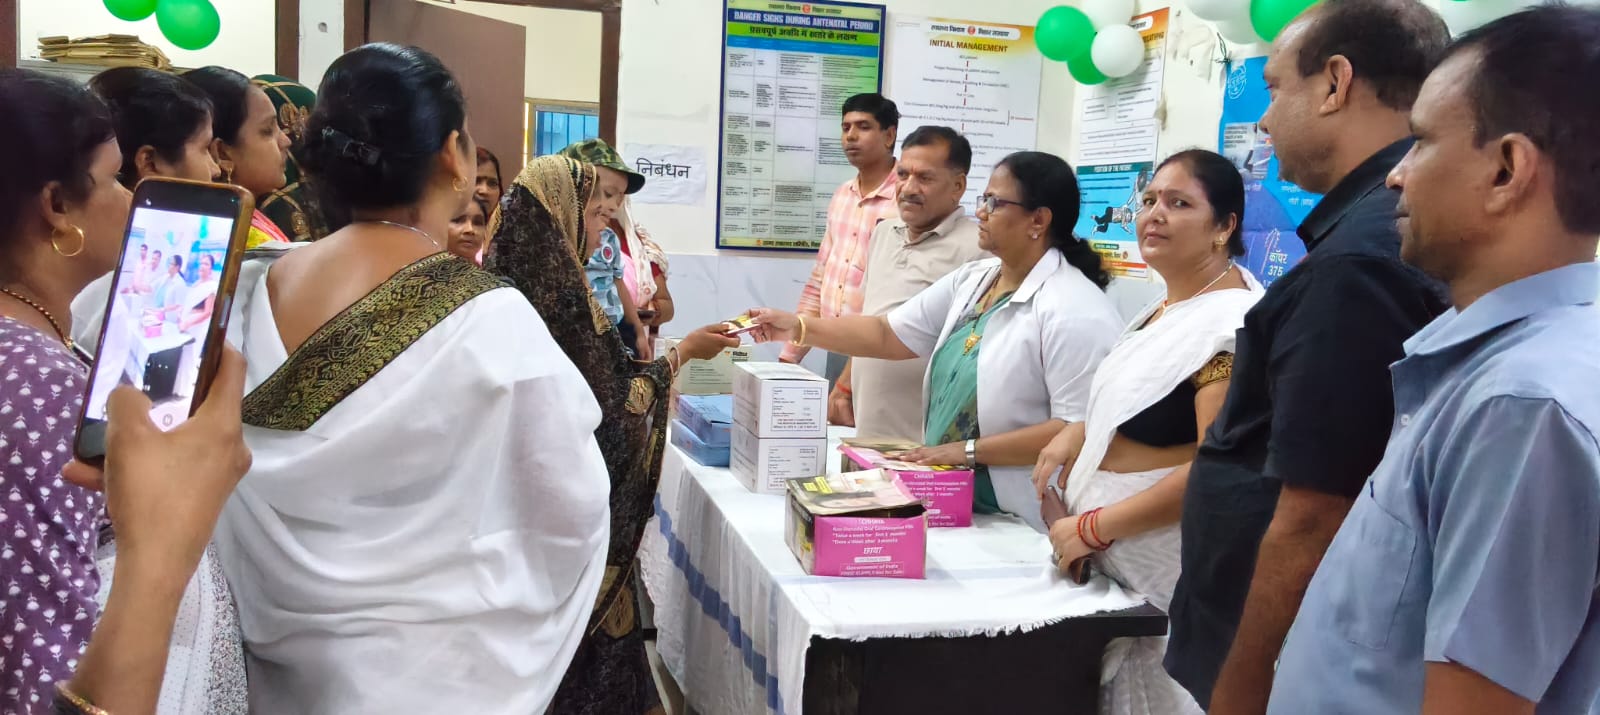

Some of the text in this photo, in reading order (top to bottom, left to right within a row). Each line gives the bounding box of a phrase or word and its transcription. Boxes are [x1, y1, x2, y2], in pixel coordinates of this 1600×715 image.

[734, 11, 874, 30] DANGER SIGNS DURING ANTENATAL PERIOD
[929, 39, 1009, 52] INITIAL MANAGEMENT
[636, 157, 692, 179] निबंधन
[1269, 249, 1288, 264] कॉपर
[1267, 265, 1284, 277] 375
